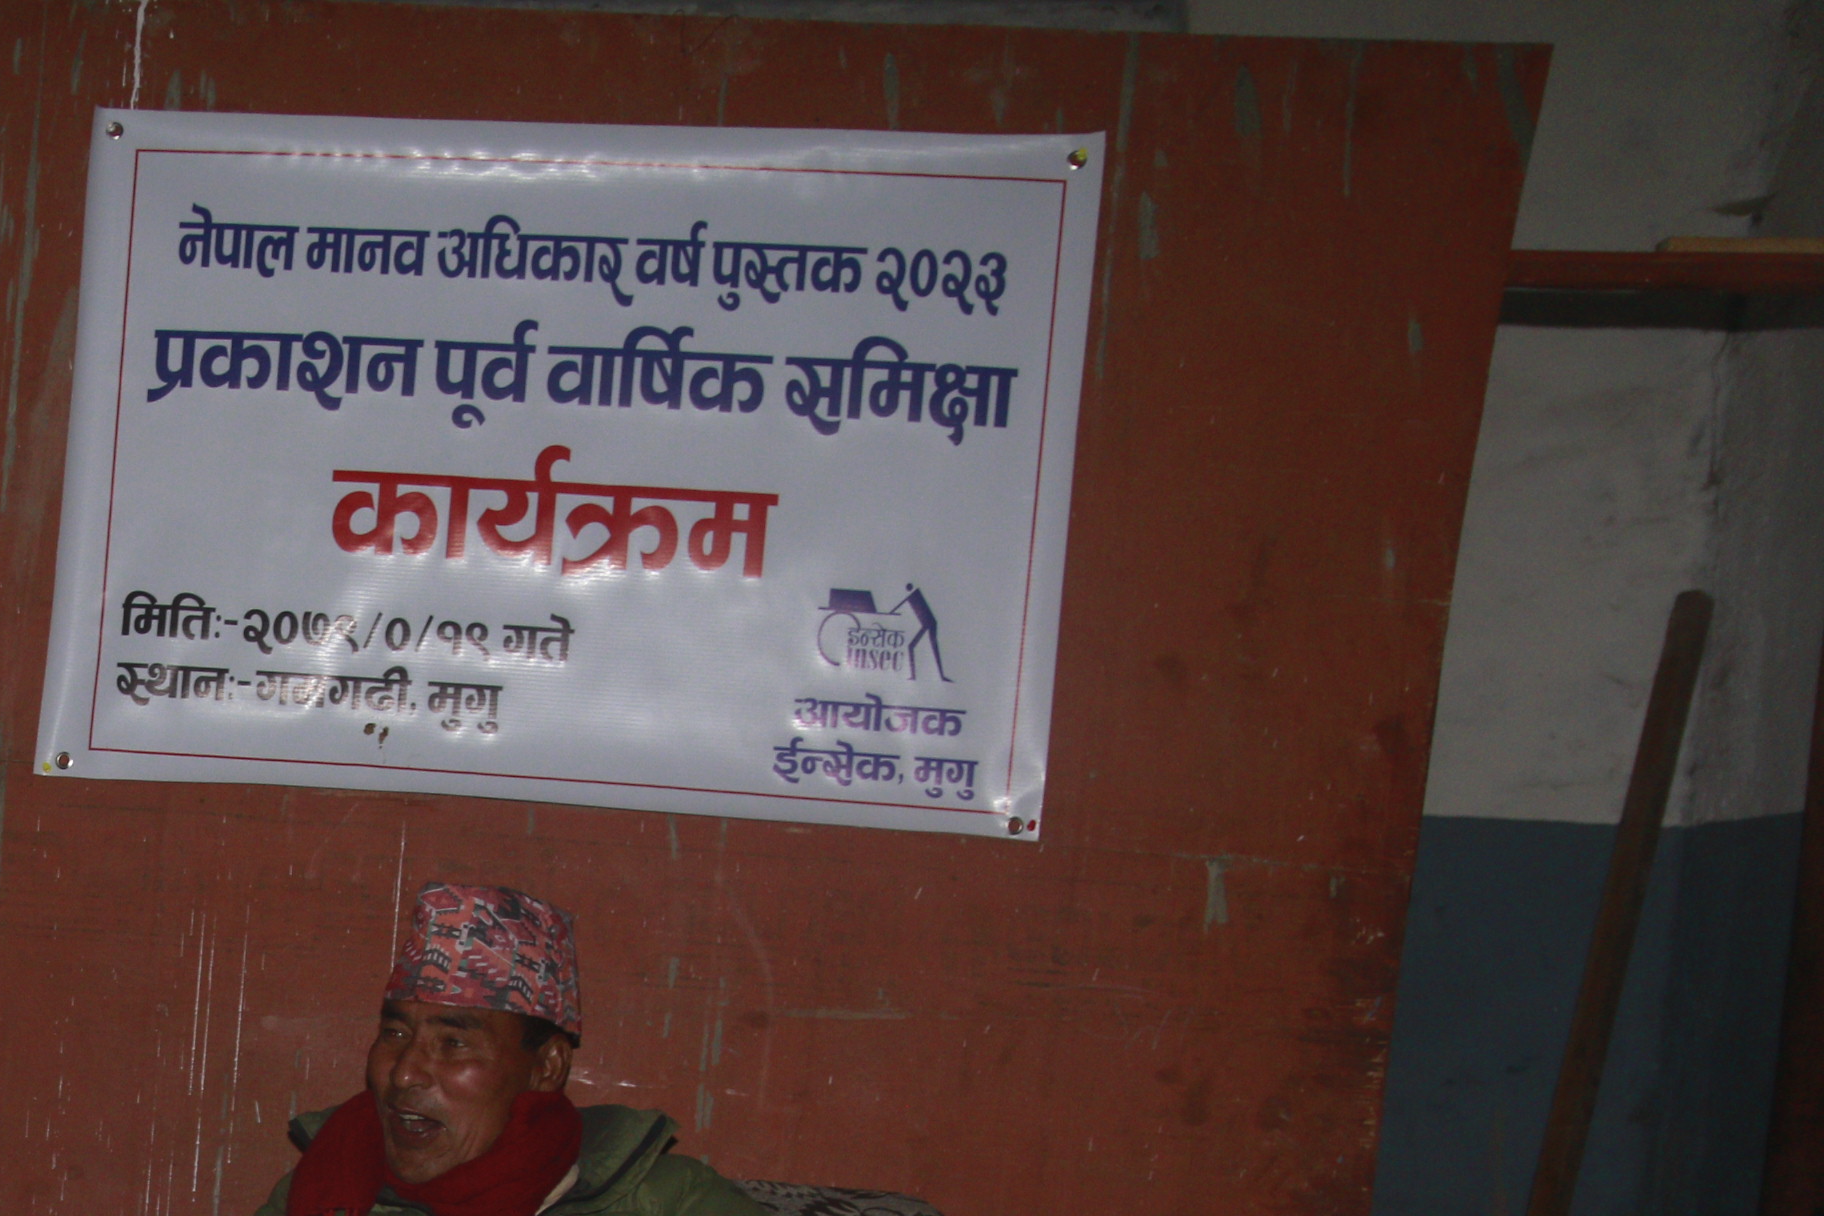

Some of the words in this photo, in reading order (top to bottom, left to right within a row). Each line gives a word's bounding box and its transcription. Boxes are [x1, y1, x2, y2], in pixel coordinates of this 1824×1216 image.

[178, 202, 299, 278] नेपाल
[306, 226, 430, 277] मानव
[437, 213, 634, 307] अधिकार
[635, 220, 708, 287] वर्ष
[712, 241, 868, 311] पुस्तक
[876, 246, 1008, 316] २०२३
[147, 328, 424, 411] प्रकाशन
[434, 318, 539, 429] पूर्व
[547, 325, 774, 414] वार्षिक
[785, 335, 1019, 446] समिक्षा
[331, 444, 780, 578] कार्यक्रम
[502, 613, 574, 661] गते
[427, 680, 503, 733] मुगु
[794, 692, 967, 736] आयोजक
[914, 756, 979, 801] मुगु
